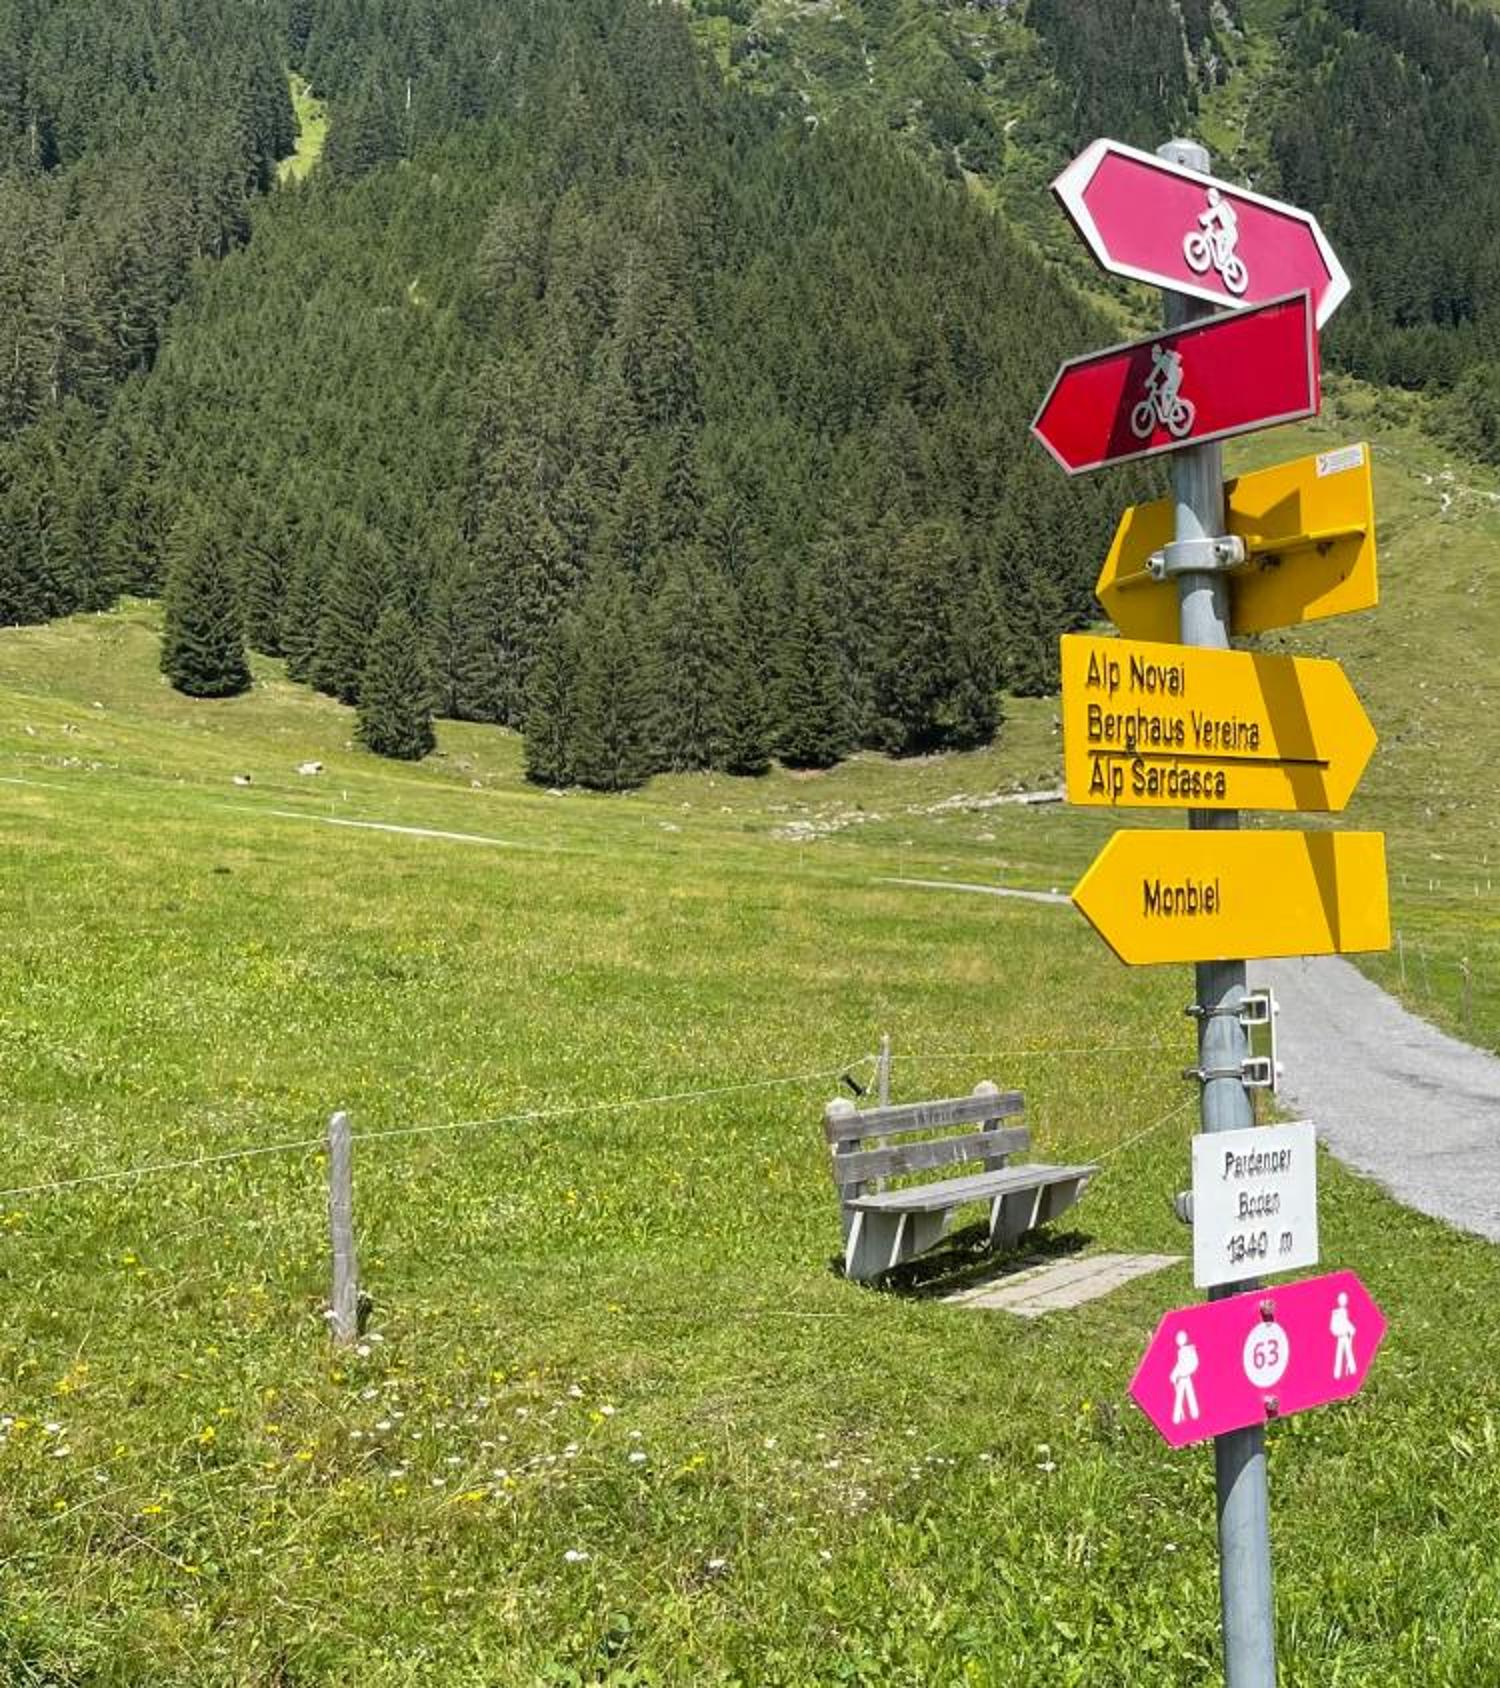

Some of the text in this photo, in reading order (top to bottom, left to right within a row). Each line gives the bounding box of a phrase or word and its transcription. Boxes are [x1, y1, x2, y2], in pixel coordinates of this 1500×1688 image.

[1087, 650, 1185, 698] Alp Novai
[1087, 704, 1260, 750] Berghaus Vereina
[1089, 755, 1226, 803] Alp Sardasca
[1143, 879, 1220, 918] Monbiel
[1237, 1190, 1280, 1219] Boden
[1280, 1231, 1293, 1255] m
[1253, 1340, 1279, 1369] 63
